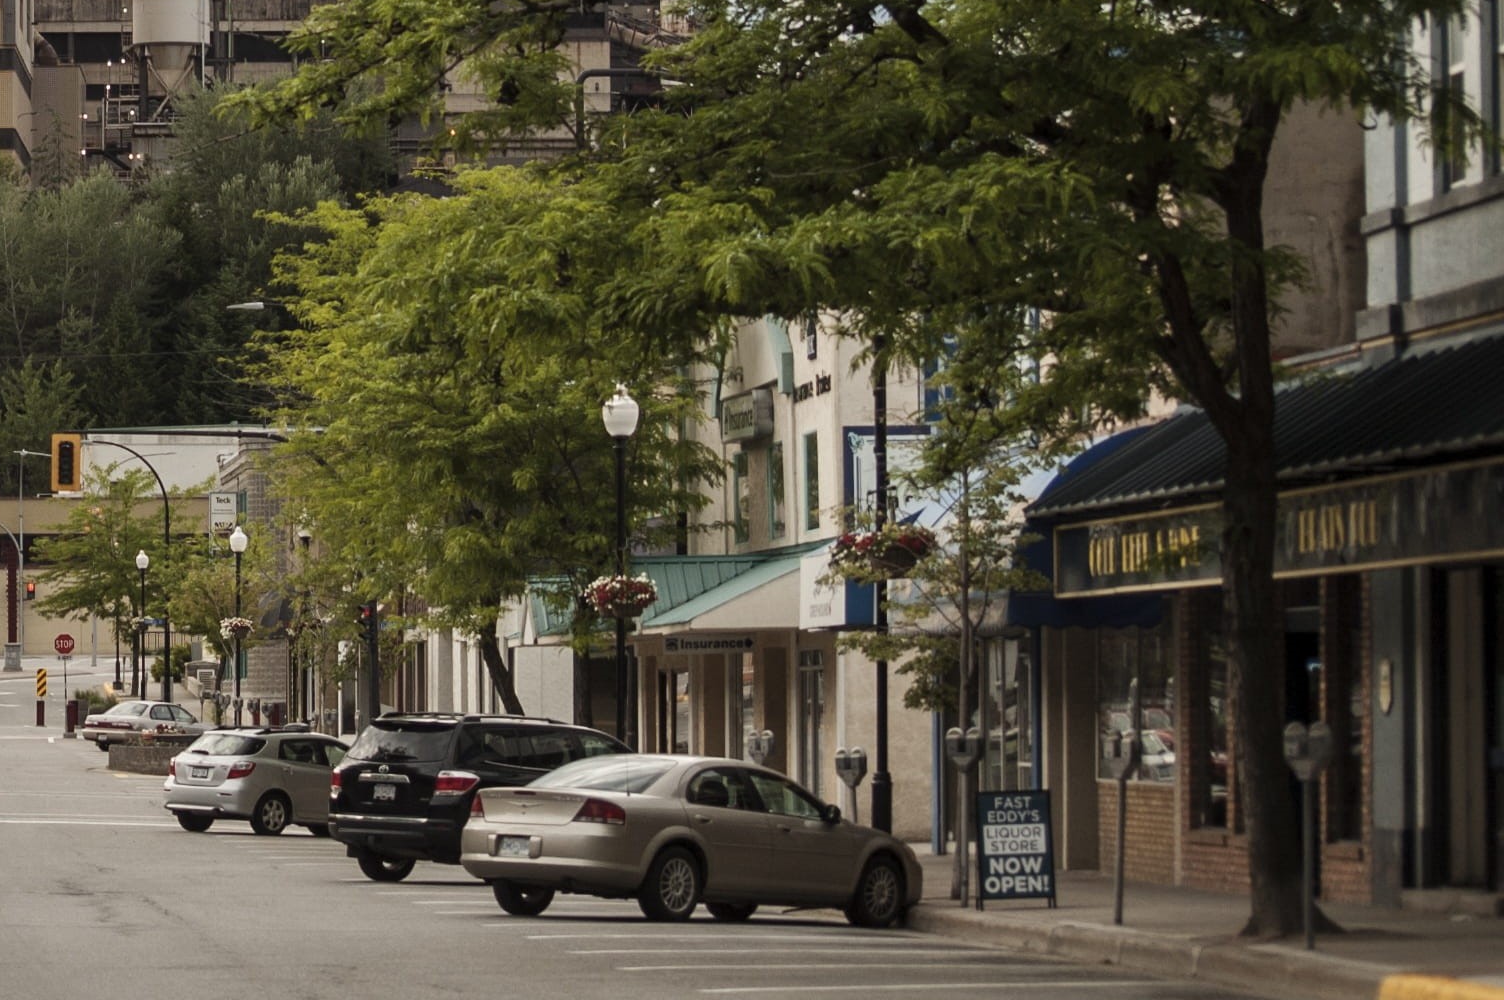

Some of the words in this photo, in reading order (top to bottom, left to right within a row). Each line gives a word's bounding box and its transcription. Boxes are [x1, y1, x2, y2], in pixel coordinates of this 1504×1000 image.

[215, 496, 231, 504] Teck
[55, 639, 74, 649] STOP
[680, 639, 744, 650] Insurance
[993, 796, 1032, 809] FAST
[987, 809, 1041, 823] EDDY'S
[986, 826, 1042, 840] LIQUOR
[990, 840, 1039, 853] STORE
[989, 856, 1043, 875] NOW
[984, 875, 1050, 893] OPEN!
